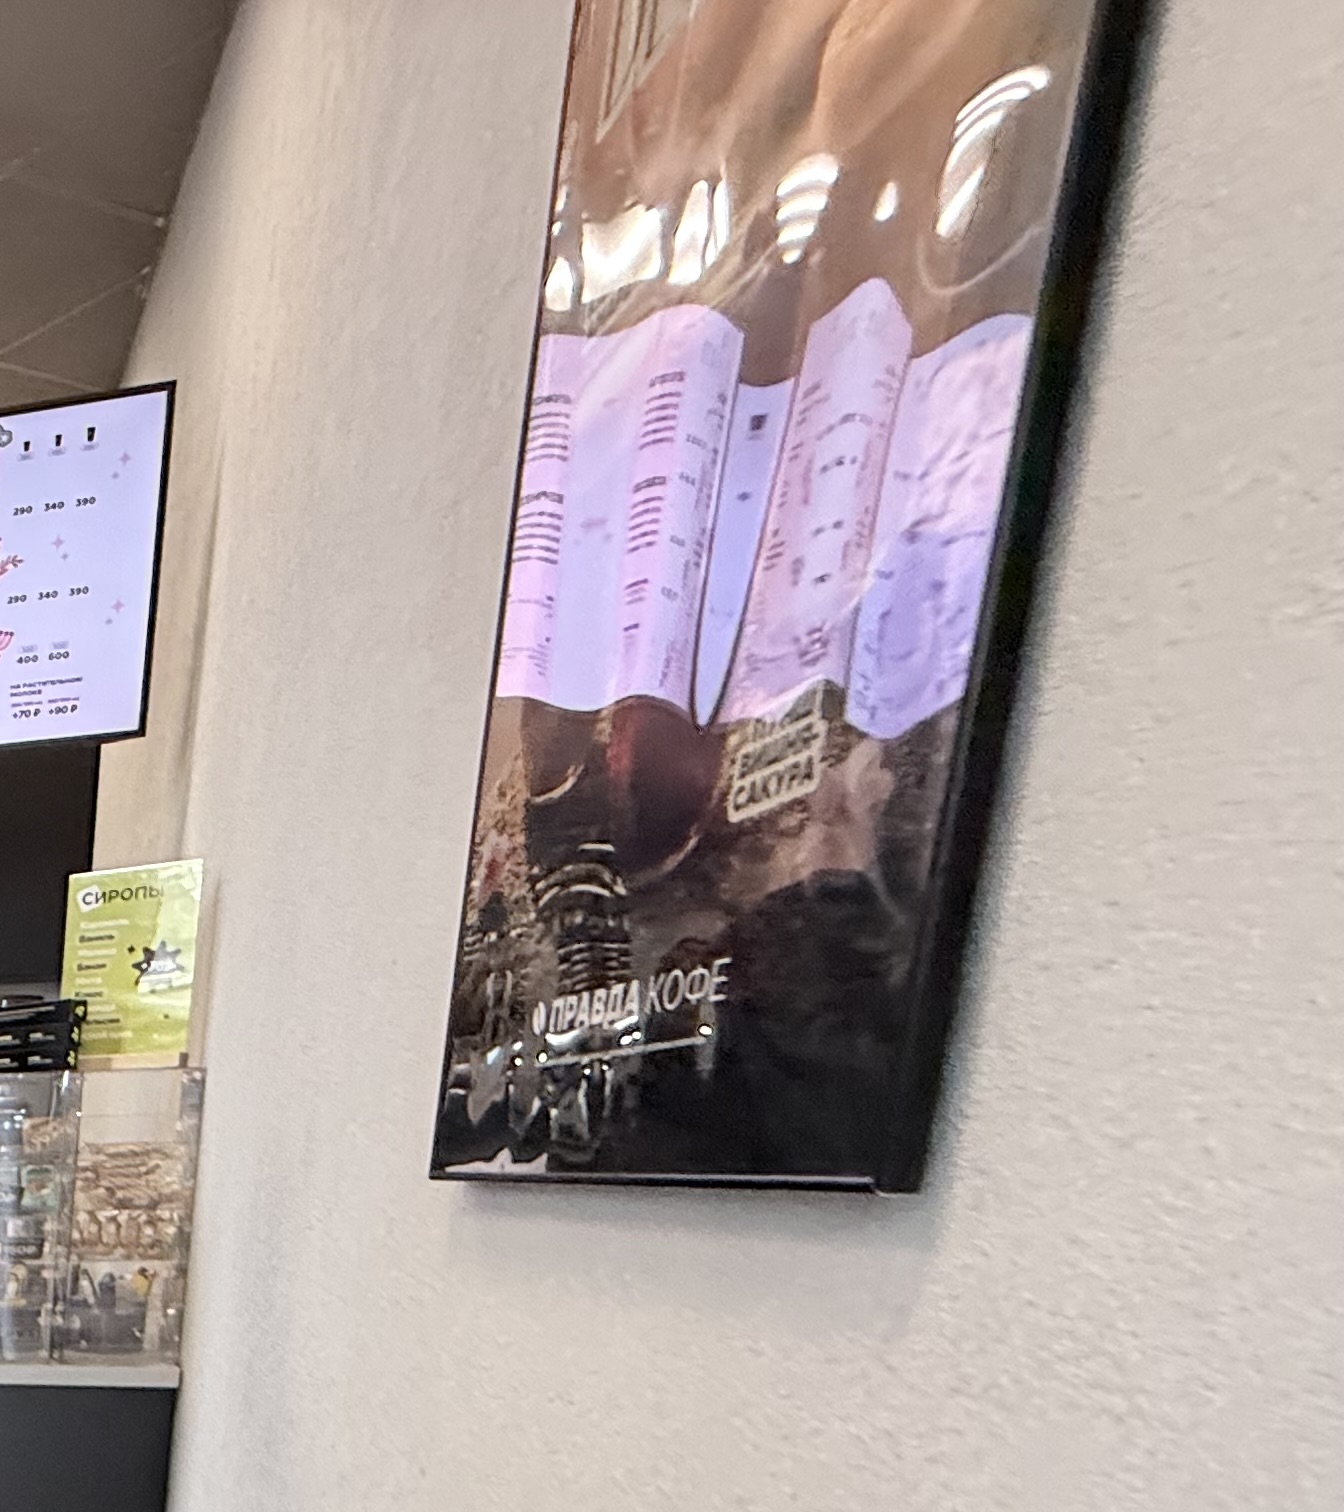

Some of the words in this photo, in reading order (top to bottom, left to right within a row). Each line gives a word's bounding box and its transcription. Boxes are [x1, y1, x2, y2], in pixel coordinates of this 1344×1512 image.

[13, 505, 33, 516] 290
[44, 501, 65, 512] 340
[76, 497, 96, 507] 390
[38, 591, 59, 600] 340
[69, 586, 89, 597] 390
[17, 655, 39, 665] 400
[49, 651, 70, 661] 600
[13, 709, 32, 720] +70
[49, 705, 69, 716] +90
[550, 980, 641, 1033] ПРАВДА
[645, 957, 733, 1015] КОФЕ
